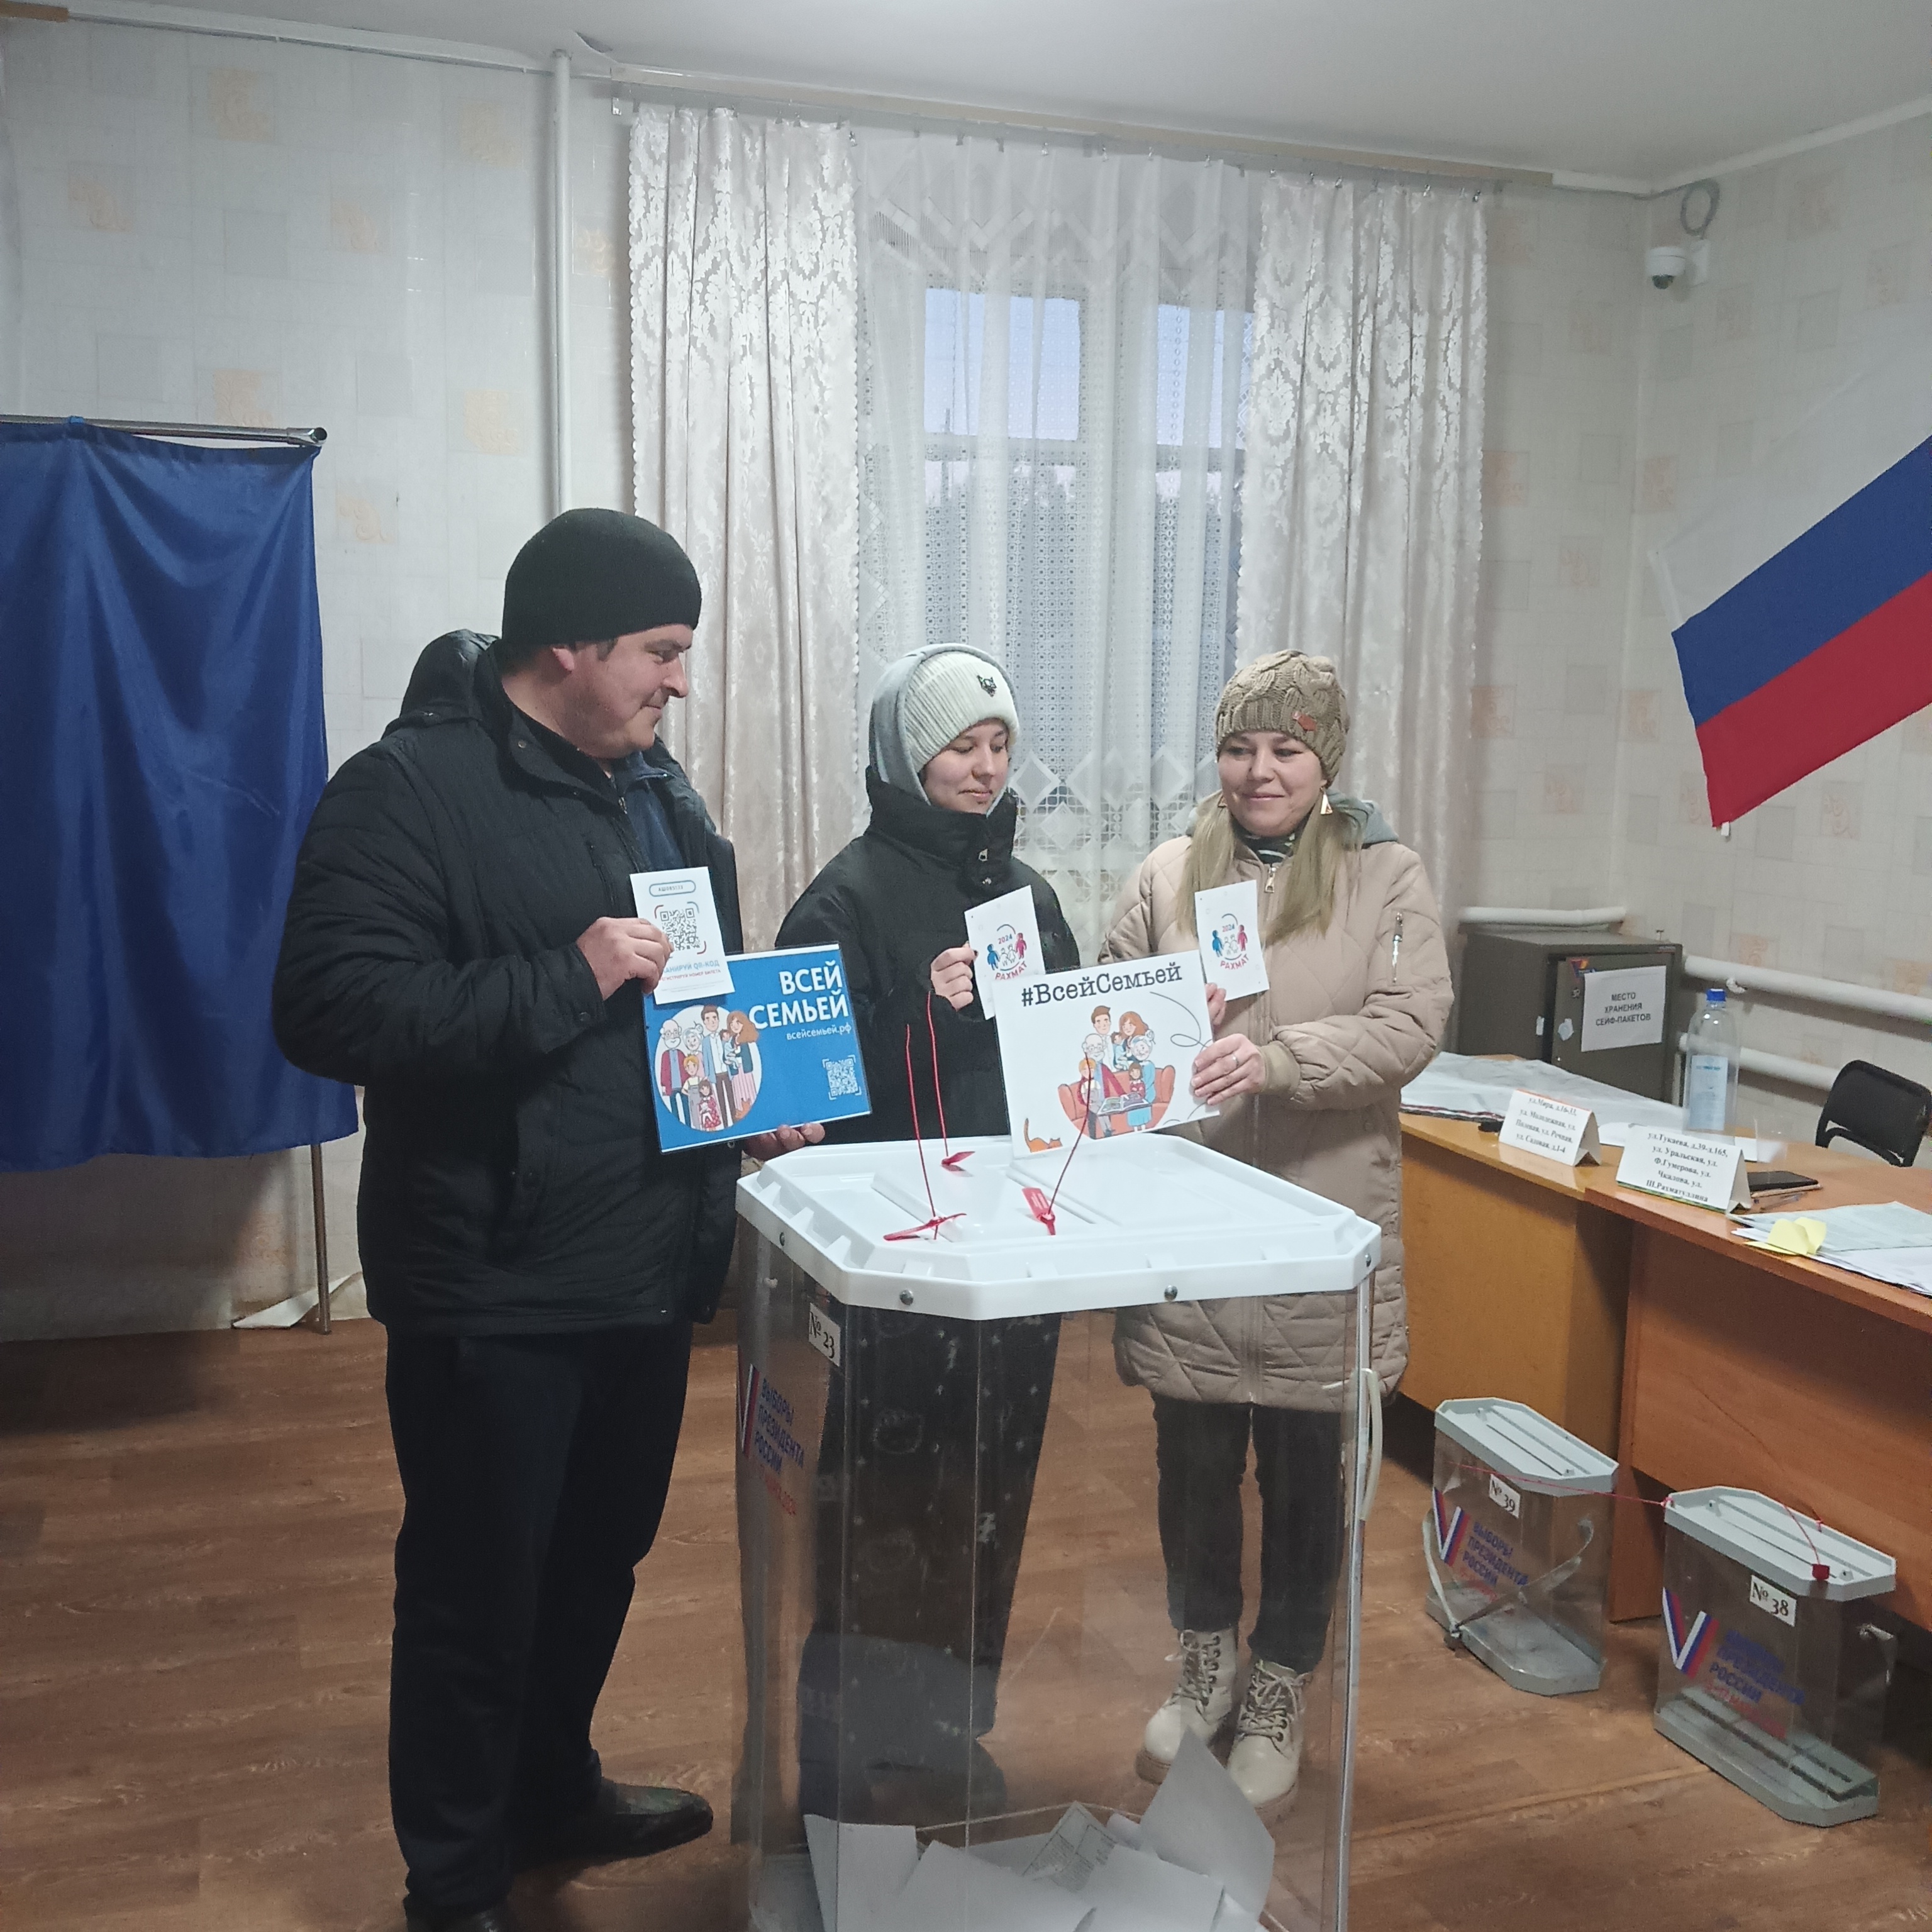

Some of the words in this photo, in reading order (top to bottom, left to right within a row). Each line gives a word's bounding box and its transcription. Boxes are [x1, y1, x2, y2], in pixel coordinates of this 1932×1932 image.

[1222, 924, 1235, 932] 2024
[998, 933, 1013, 944] 2024
[664, 962, 692, 973] АНИРУЙ
[995, 960, 1027, 980] РАХМАТ
[1220, 953, 1249, 970] РАХМАТ
[779, 960, 843, 995] ВСЕЙ
[1021, 962, 1182, 1007] #ВсейСемьей
[1611, 992, 1636, 1001] МЕСТО
[748, 989, 848, 1030] СЕМЬЕЙ
[1604, 1002, 1643, 1013] ХРАНЕНИЯ
[1596, 1013, 1652, 1026] СЕЙФ-ПАКЕТОВ
[786, 1022, 852, 1040] всейсемьей.рф
[1647, 1132, 1689, 1148] ул.Тукаева,
[1652, 1145, 1662, 1153] ул.
[1665, 1147, 1706, 1165] Уральская,
[1706, 1159, 1718, 1167] ул.
[1654, 1157, 1699, 1175] Ф.Гумерова,
[1699, 1170, 1711, 1178] ул.
[1658, 1170, 1690, 1185] Чкалова,
[1646, 1179, 1708, 1202] Ш.Рахматуллина
[823, 1331, 835, 1358] 23
[1503, 1494, 1516, 1513] 39
[1752, 1581, 1769, 1601] №
[1770, 1598, 1789, 1617] 38
